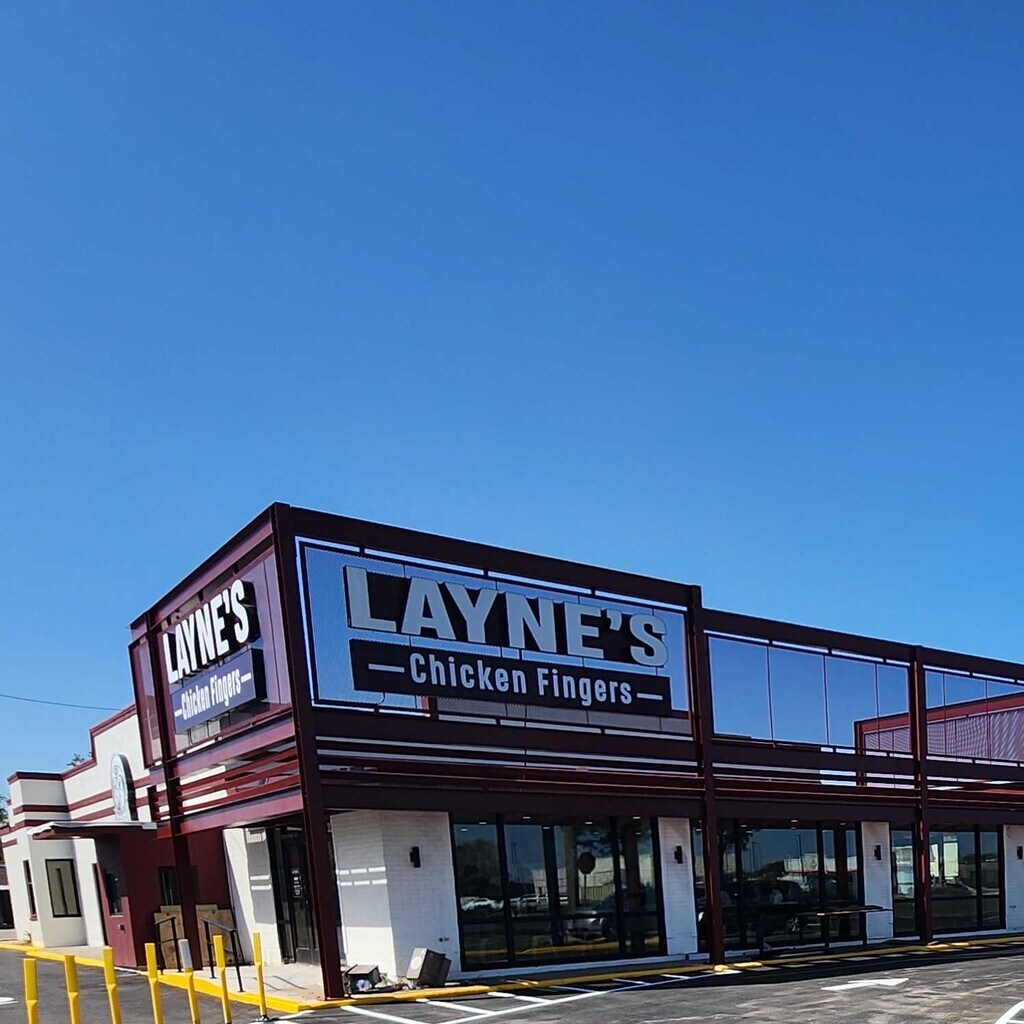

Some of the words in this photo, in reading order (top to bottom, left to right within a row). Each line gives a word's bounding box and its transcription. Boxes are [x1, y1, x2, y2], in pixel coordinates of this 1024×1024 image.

[162, 578, 250, 684] LAYNE'S
[344, 565, 669, 668] LAYNE'S
[181, 685, 210, 721] Chicken
[210, 668, 242, 707] Fingers
[409, 652, 529, 695] Chicken
[537, 666, 634, 707] Fingers
